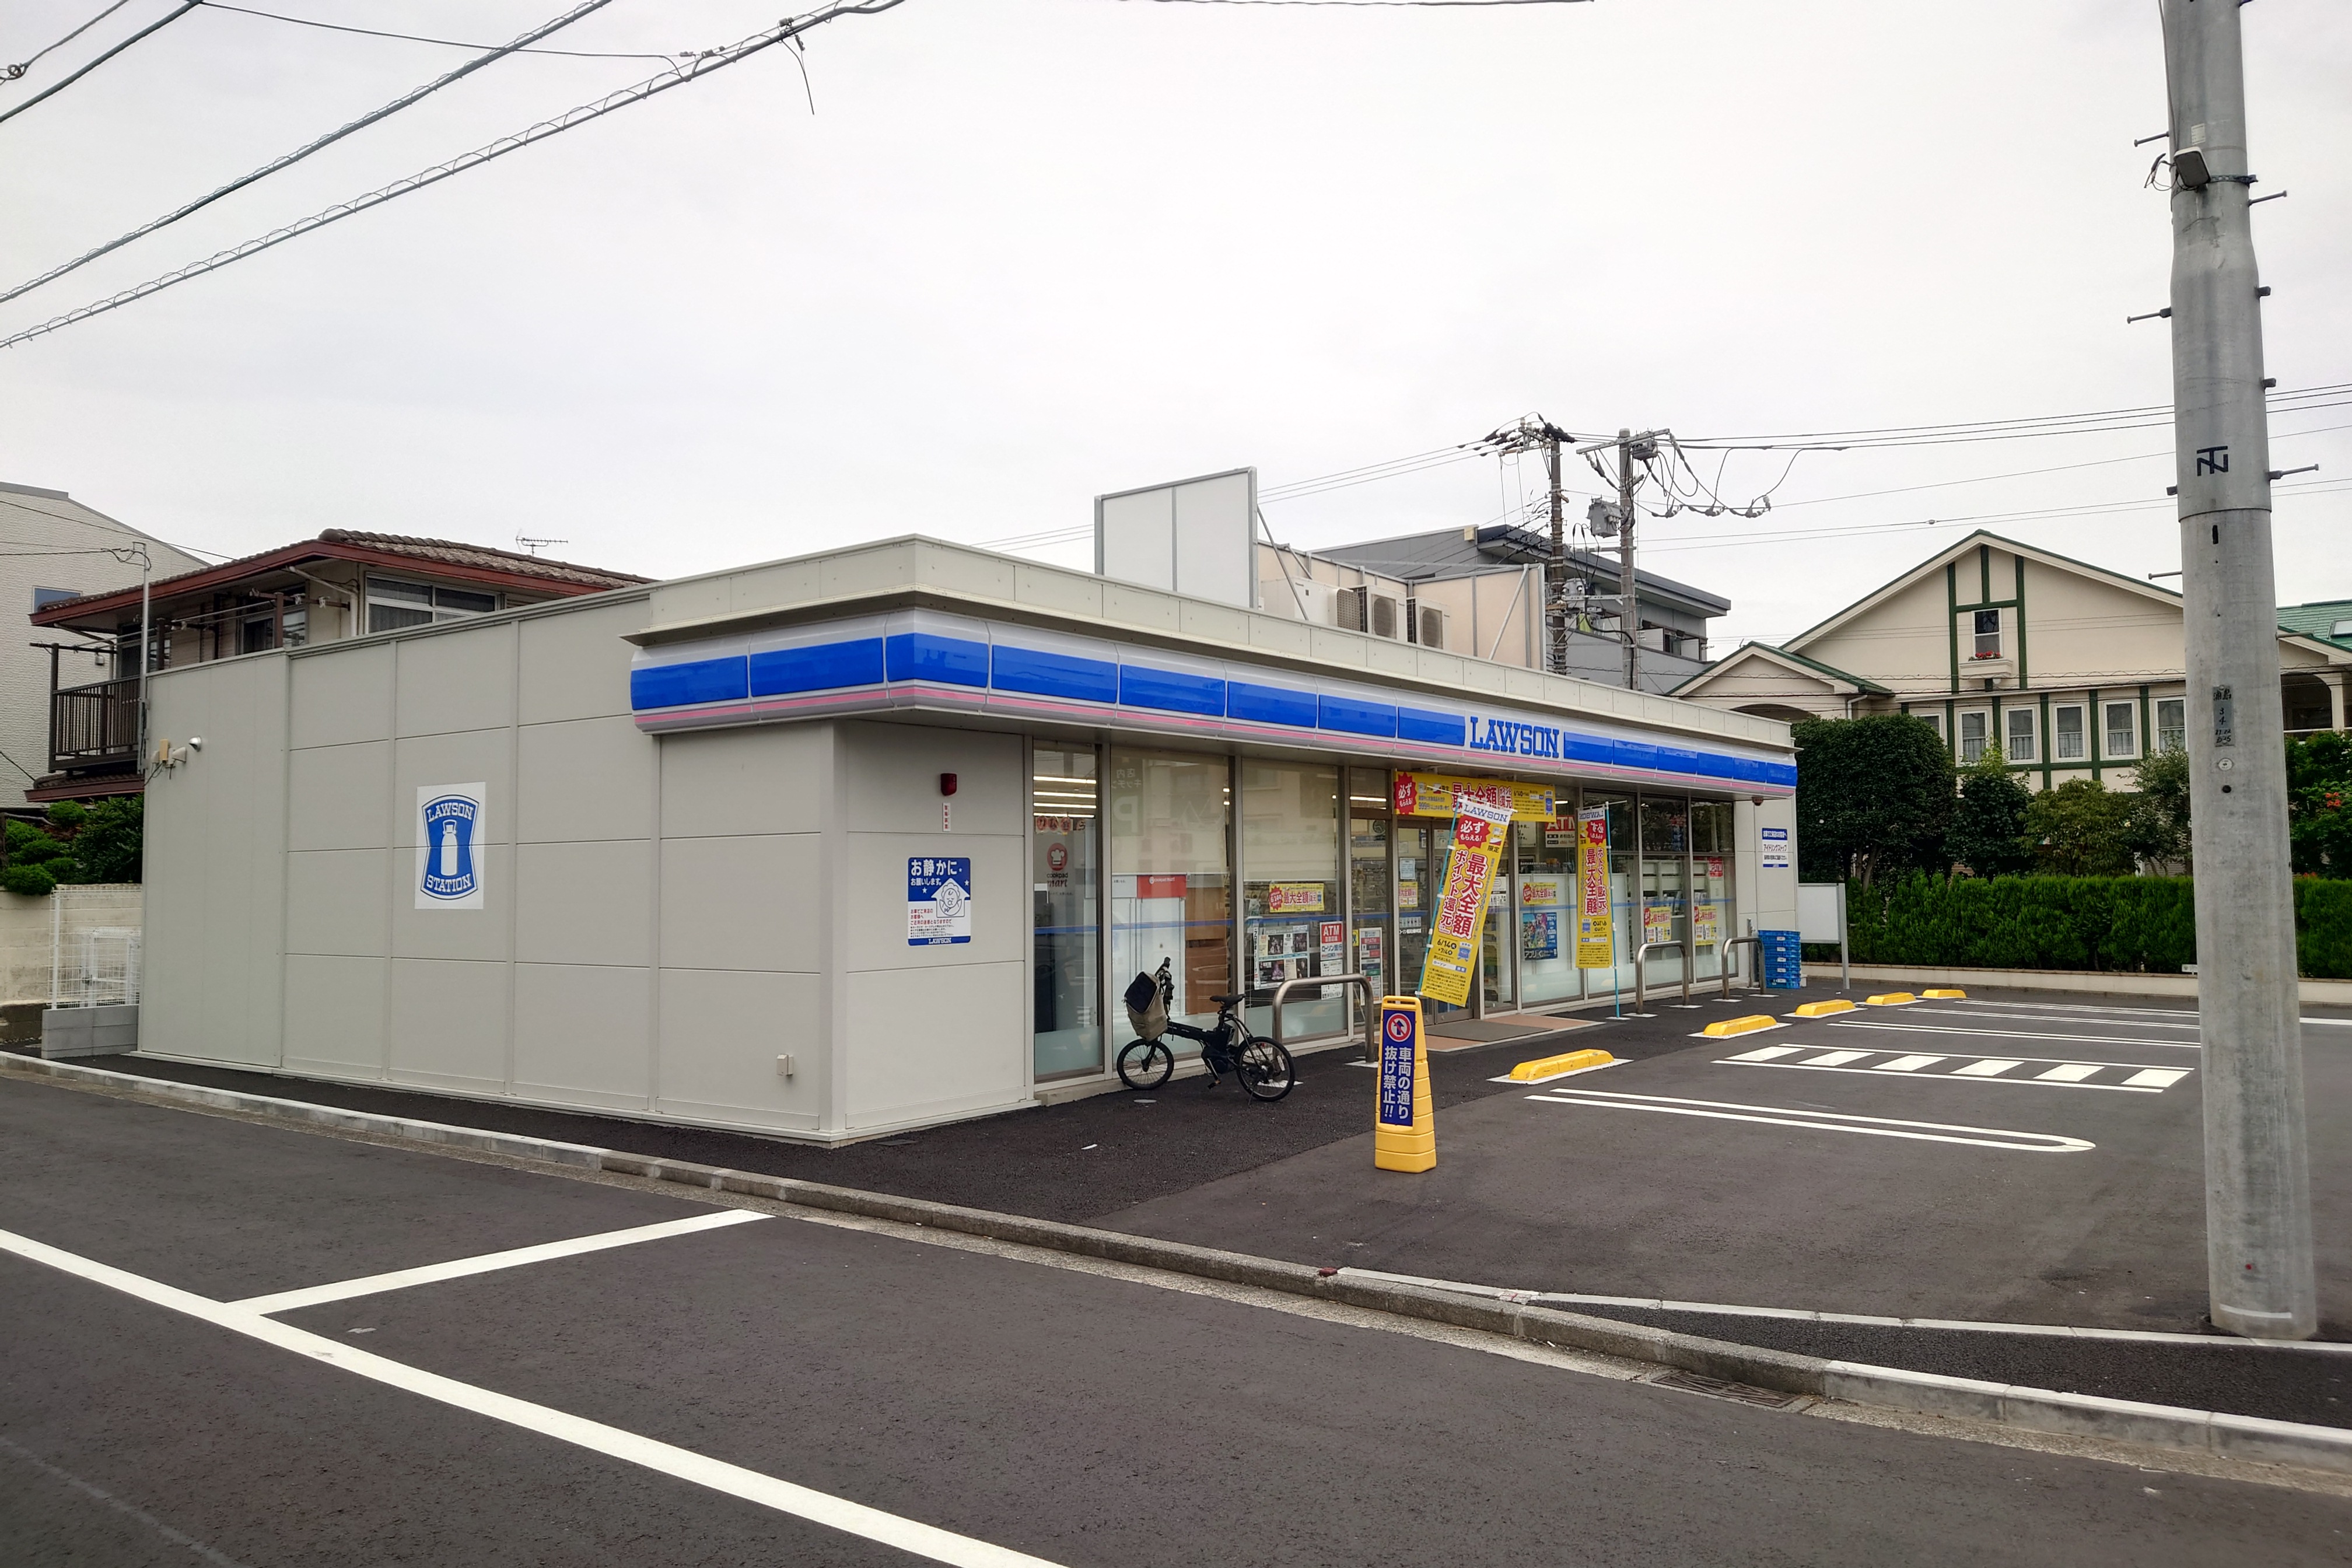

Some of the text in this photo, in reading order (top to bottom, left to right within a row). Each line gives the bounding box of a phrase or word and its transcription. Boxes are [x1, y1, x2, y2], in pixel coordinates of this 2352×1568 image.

[1470, 716, 1559, 758] LAWSON
[1399, 782, 1412, 799] 必ず
[427, 803, 473, 822] LAWSON
[1464, 804, 1508, 822] LAWSON
[1460, 820, 1485, 834] 必ず
[1460, 834, 1482, 842] もらえる!
[1488, 845, 1500, 853] 限定
[911, 859, 957, 877] お静かに
[426, 873, 471, 892] STATION
[911, 877, 942, 886] お願いします。
[1048, 879, 1068, 887] mart
[1440, 851, 1468, 926] ポイント還元
[1283, 891, 1309, 904] 最大全額
[1452, 853, 1487, 937] 最大全額
[1323, 925, 1339, 936] ATM
[1383, 1046, 1397, 1118] 抜け禁止!!
[1398, 1047, 1412, 1119] 車両の通り
